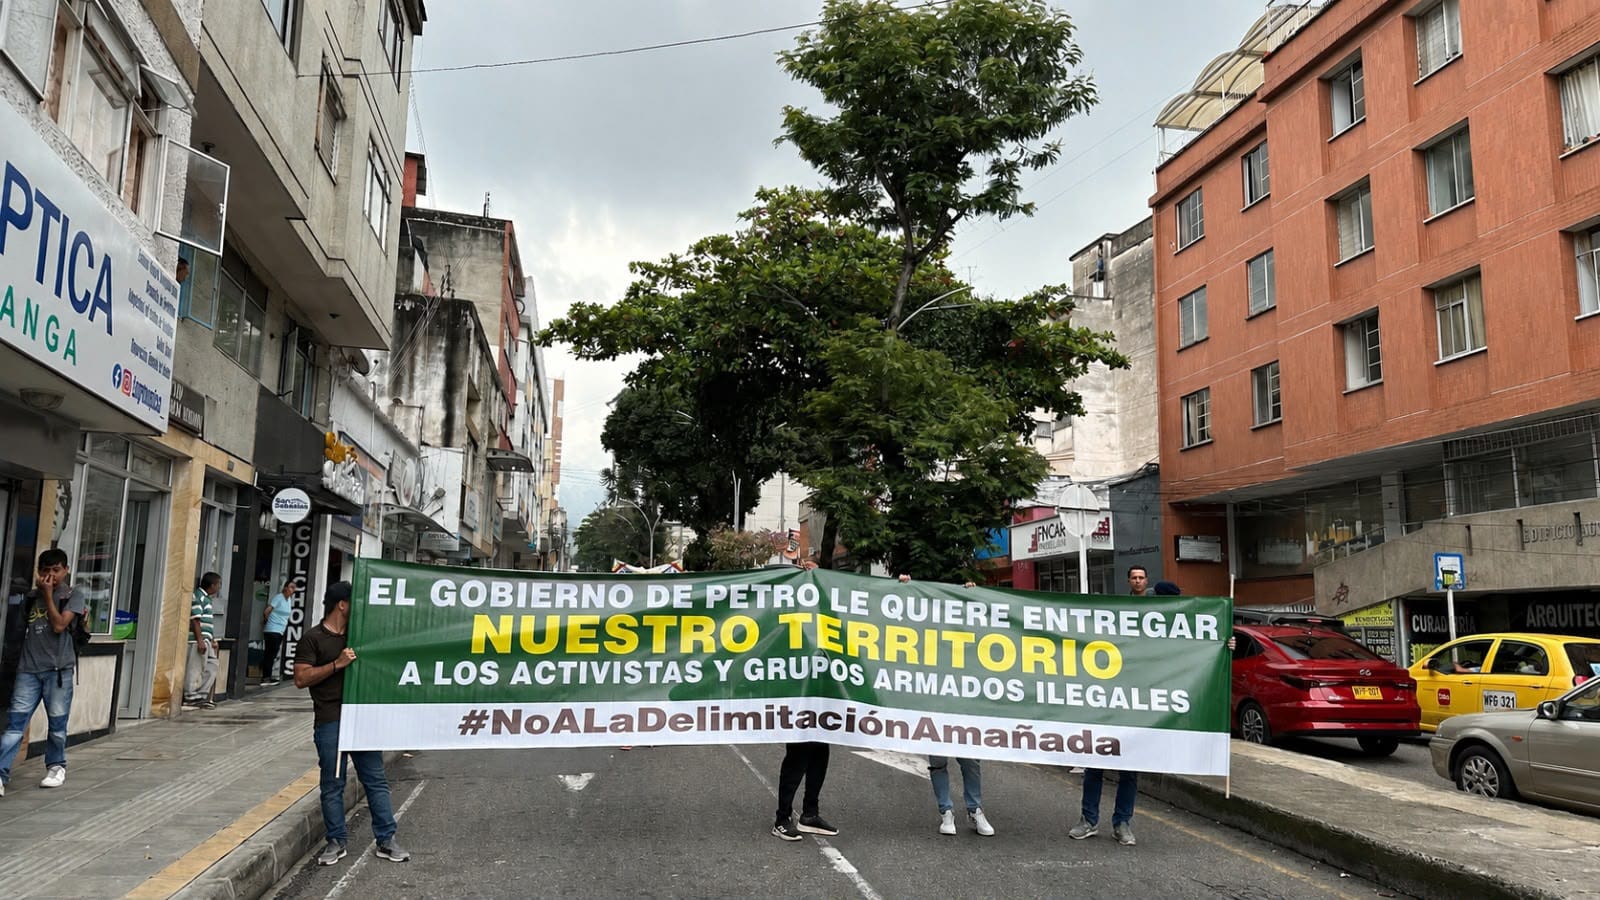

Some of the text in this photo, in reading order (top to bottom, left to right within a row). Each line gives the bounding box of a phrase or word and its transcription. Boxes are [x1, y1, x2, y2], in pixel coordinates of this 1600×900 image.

[284, 525, 311, 675] COLCHONES
[368, 577, 1219, 641] EL GOBIERNO DE PETRO LE QUIERE ENTREGAR
[471, 612, 1124, 680] NUESTRO TERRITORIO
[398, 656, 1190, 713] A LOS ACTIVISTAS Y GRUPOS ARMADOS ILEGALES
[1483, 694, 1515, 708] WFG 321
[457, 705, 1121, 757] #NoALaDelimitaciónAmañada
